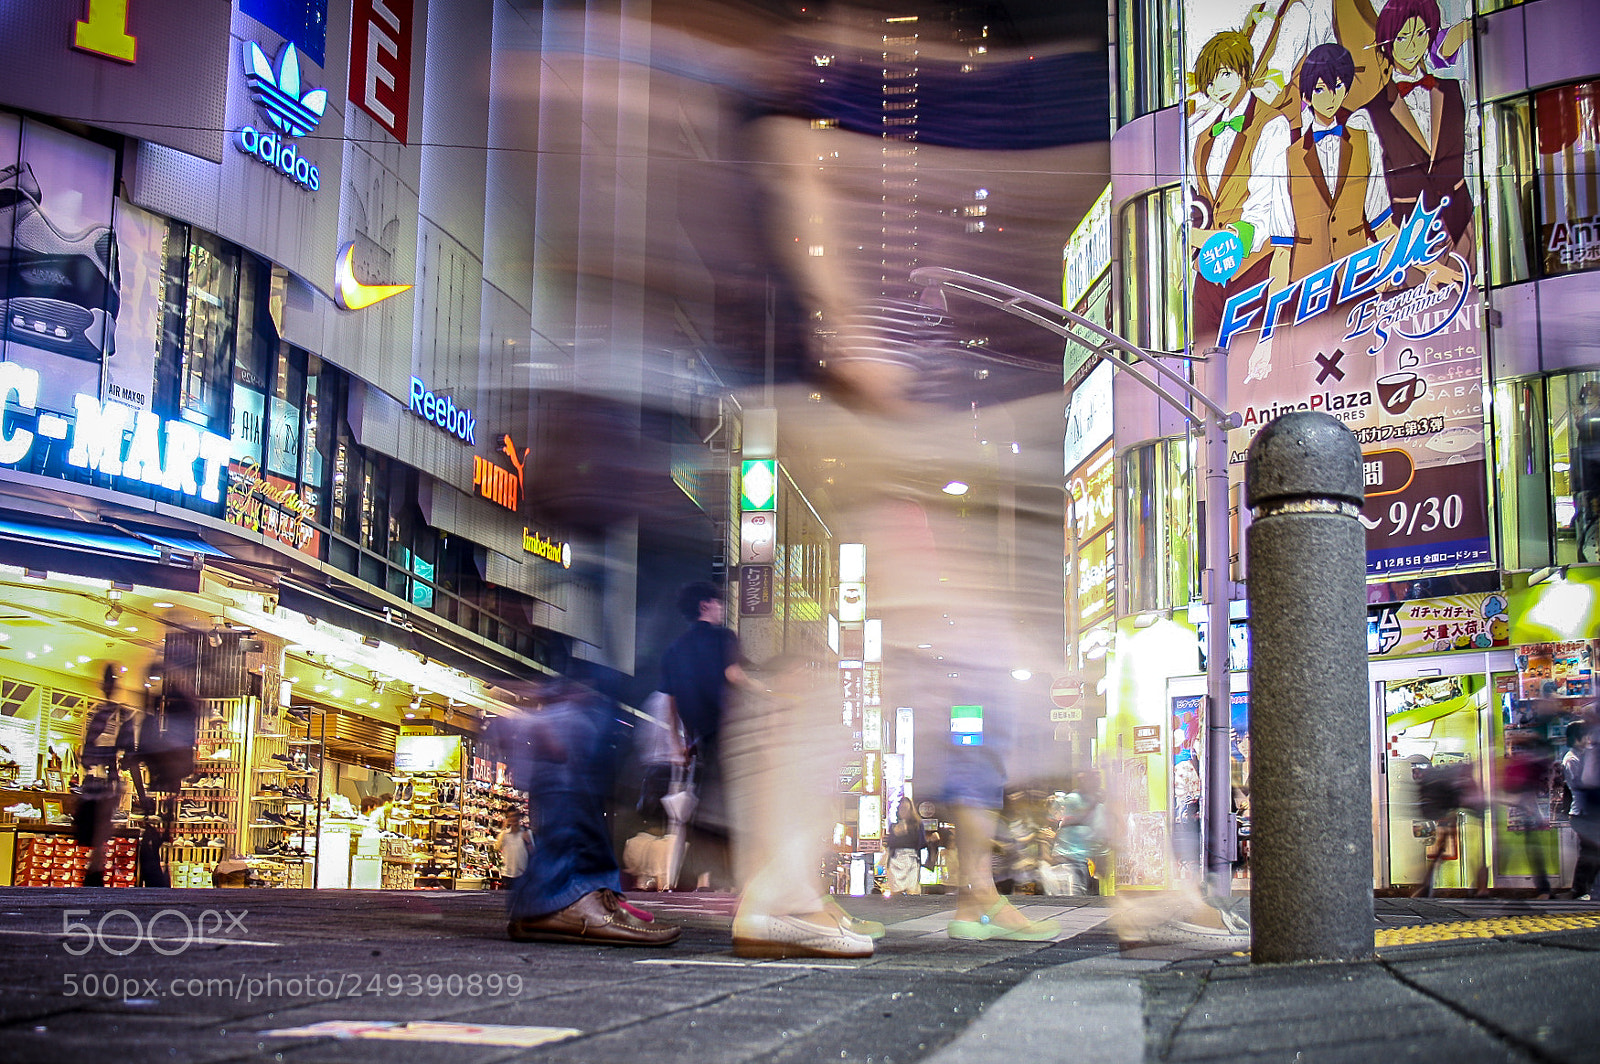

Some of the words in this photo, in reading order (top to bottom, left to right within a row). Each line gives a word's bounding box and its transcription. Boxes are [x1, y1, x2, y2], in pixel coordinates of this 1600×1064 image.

[240, 125, 320, 192] adidas
[1202, 238, 1238, 265] 当ビル
[1213, 255, 1236, 275] 4階
[1342, 270, 1437, 343] Eternal
[1365, 282, 1458, 357] Summer
[1424, 346, 1477, 364] Pasta
[109, 383, 121, 398] AIR
[1427, 382, 1482, 401] SABA
[410, 375, 477, 445] Reebok
[1243, 390, 1372, 427] AnimePlaza
[473, 455, 518, 512] PUMA
[523, 526, 562, 563] Timberland
[1410, 606, 1475, 618] ガチャガチャ
[1423, 620, 1486, 641] 大量入荷!
[475, 763, 491, 782] SALE
